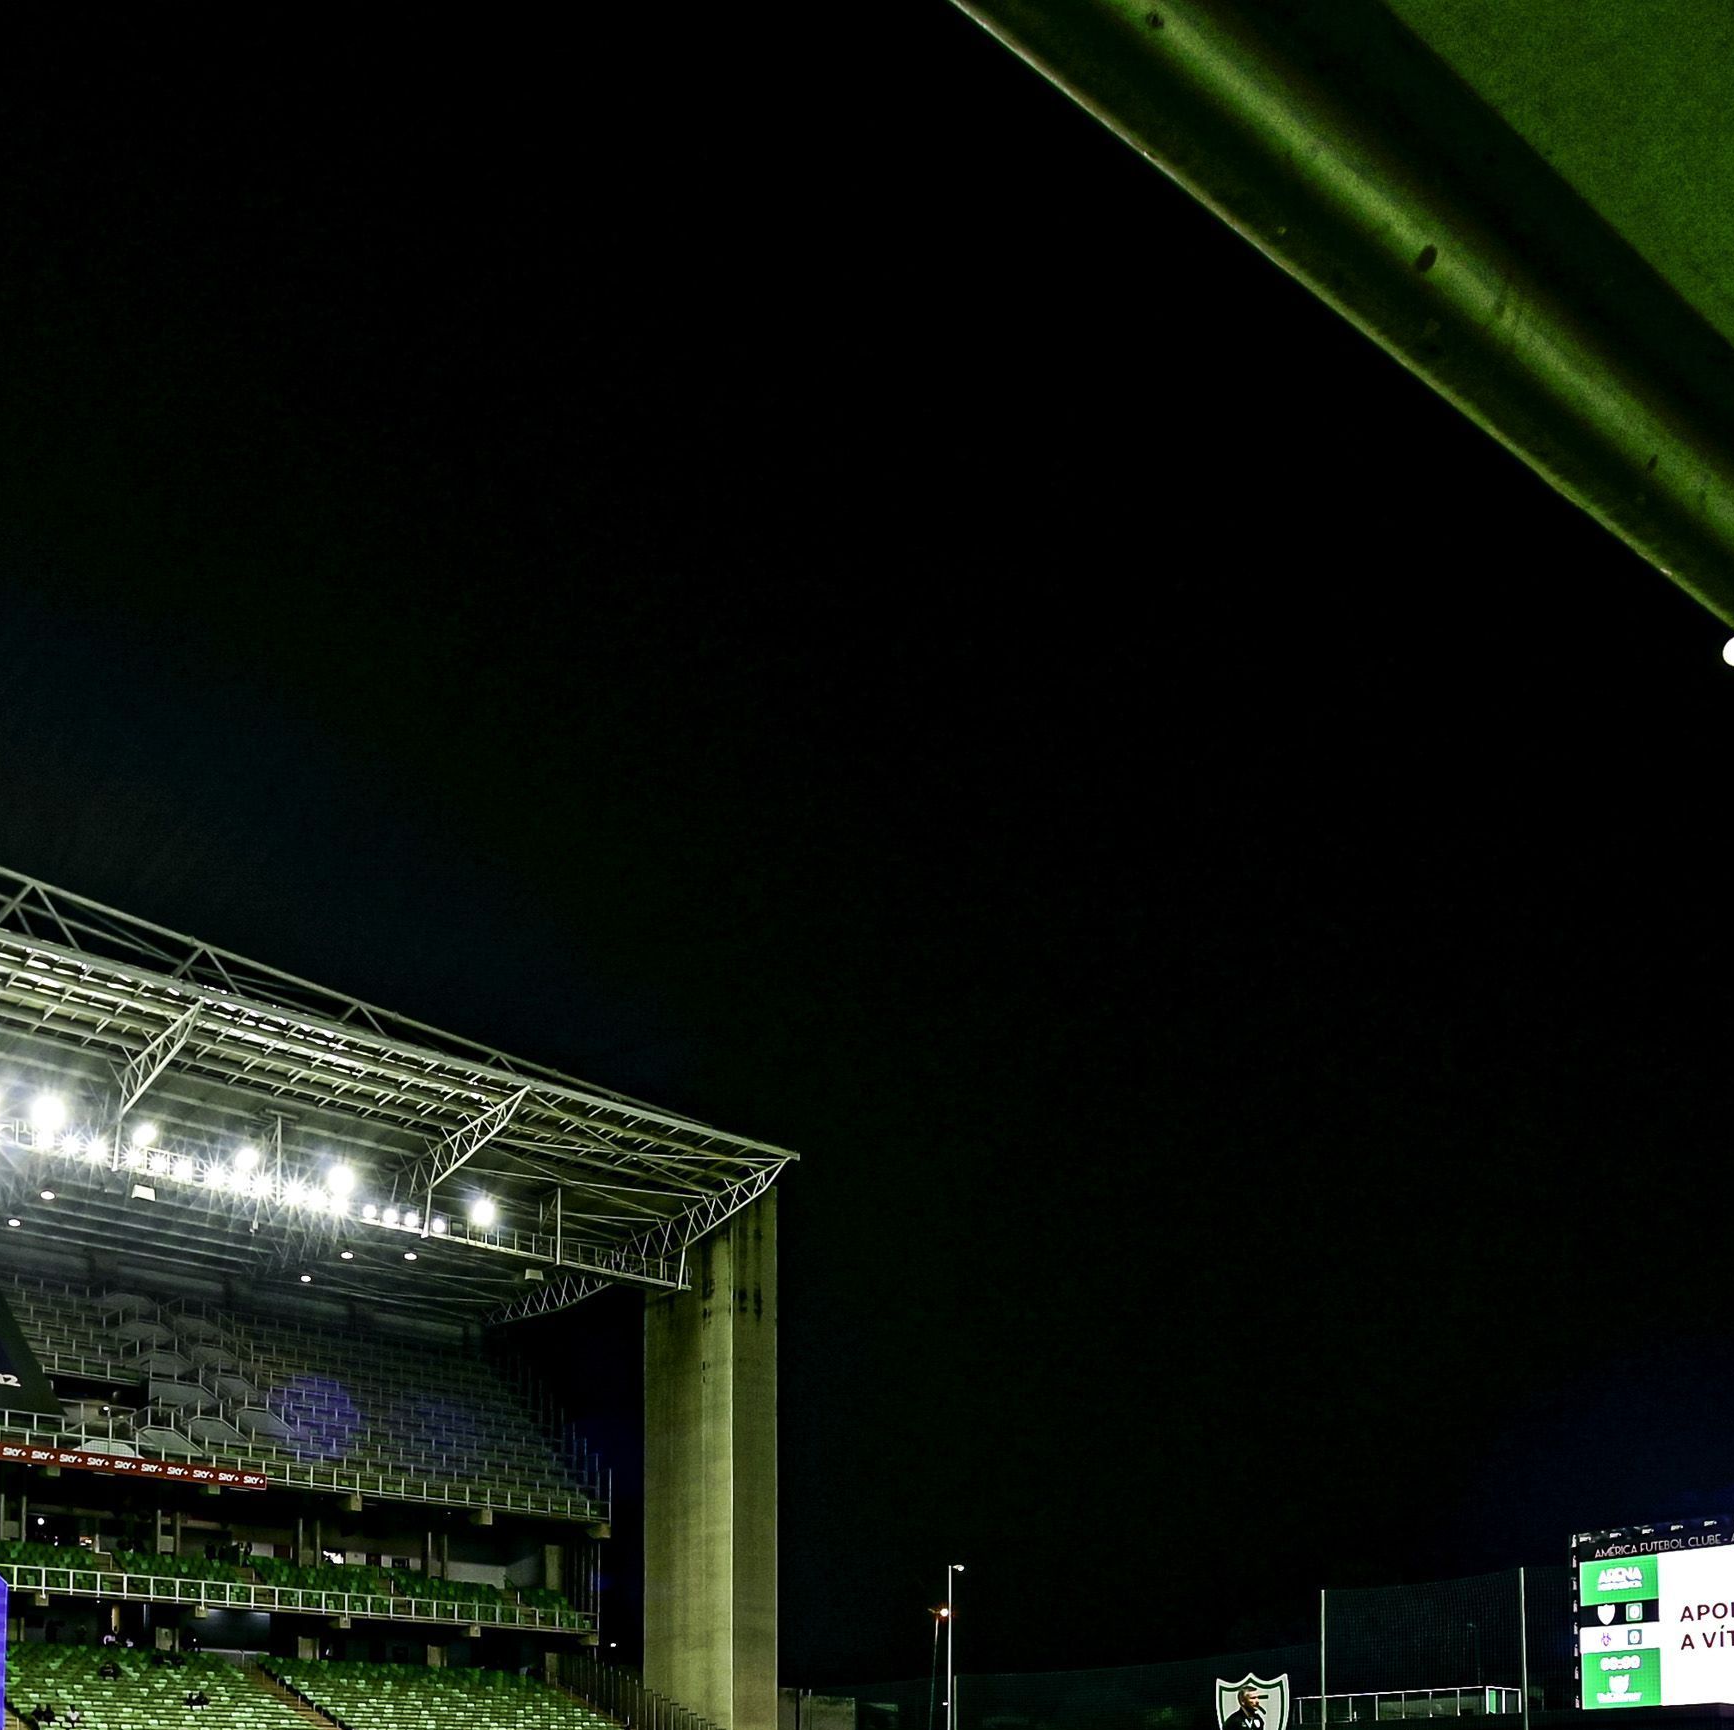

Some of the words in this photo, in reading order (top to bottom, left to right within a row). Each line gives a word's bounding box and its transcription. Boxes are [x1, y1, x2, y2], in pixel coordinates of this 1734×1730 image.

[2, 1446, 27, 1457] SKY+
[31, 1450, 55, 1460] SKY+
[59, 1453, 83, 1464] SKY+
[86, 1457, 110, 1467] SKY+
[113, 1460, 137, 1470] SKY+
[140, 1463, 163, 1473] SKY+
[166, 1466, 189, 1476] SKY+
[192, 1469, 214, 1479] SKY+
[218, 1472, 240, 1482] SKY+
[243, 1474, 264, 1485] SKY+
[1594, 1543, 1638, 1559] AMÉRICA
[1639, 1537, 1685, 1553] FUTEBOL
[1688, 1533, 1722, 1547] CLUBE
[1681, 1634, 1695, 1650] A
